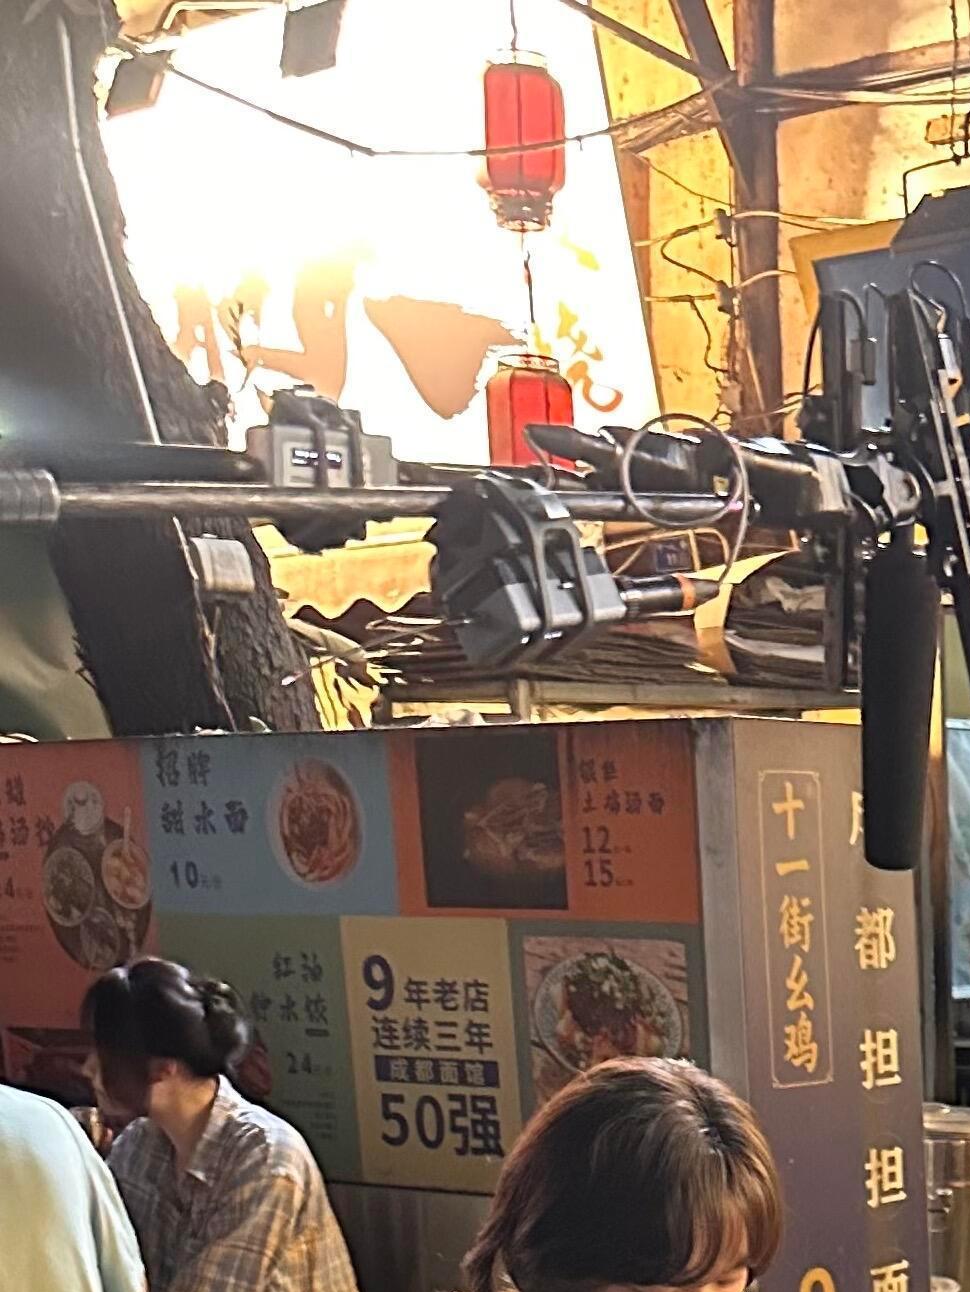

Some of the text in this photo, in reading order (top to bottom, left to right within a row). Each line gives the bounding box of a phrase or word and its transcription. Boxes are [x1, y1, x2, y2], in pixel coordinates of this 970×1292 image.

[582, 825, 612, 854] 12
[170, 860, 199, 889] 10
[584, 859, 614, 887] 15
[362, 954, 490, 1013] 9年老店
[371, 1015, 494, 1055] 连续三年
[389, 1056, 486, 1086] 成都面馆
[380, 1092, 506, 1158] 50强
